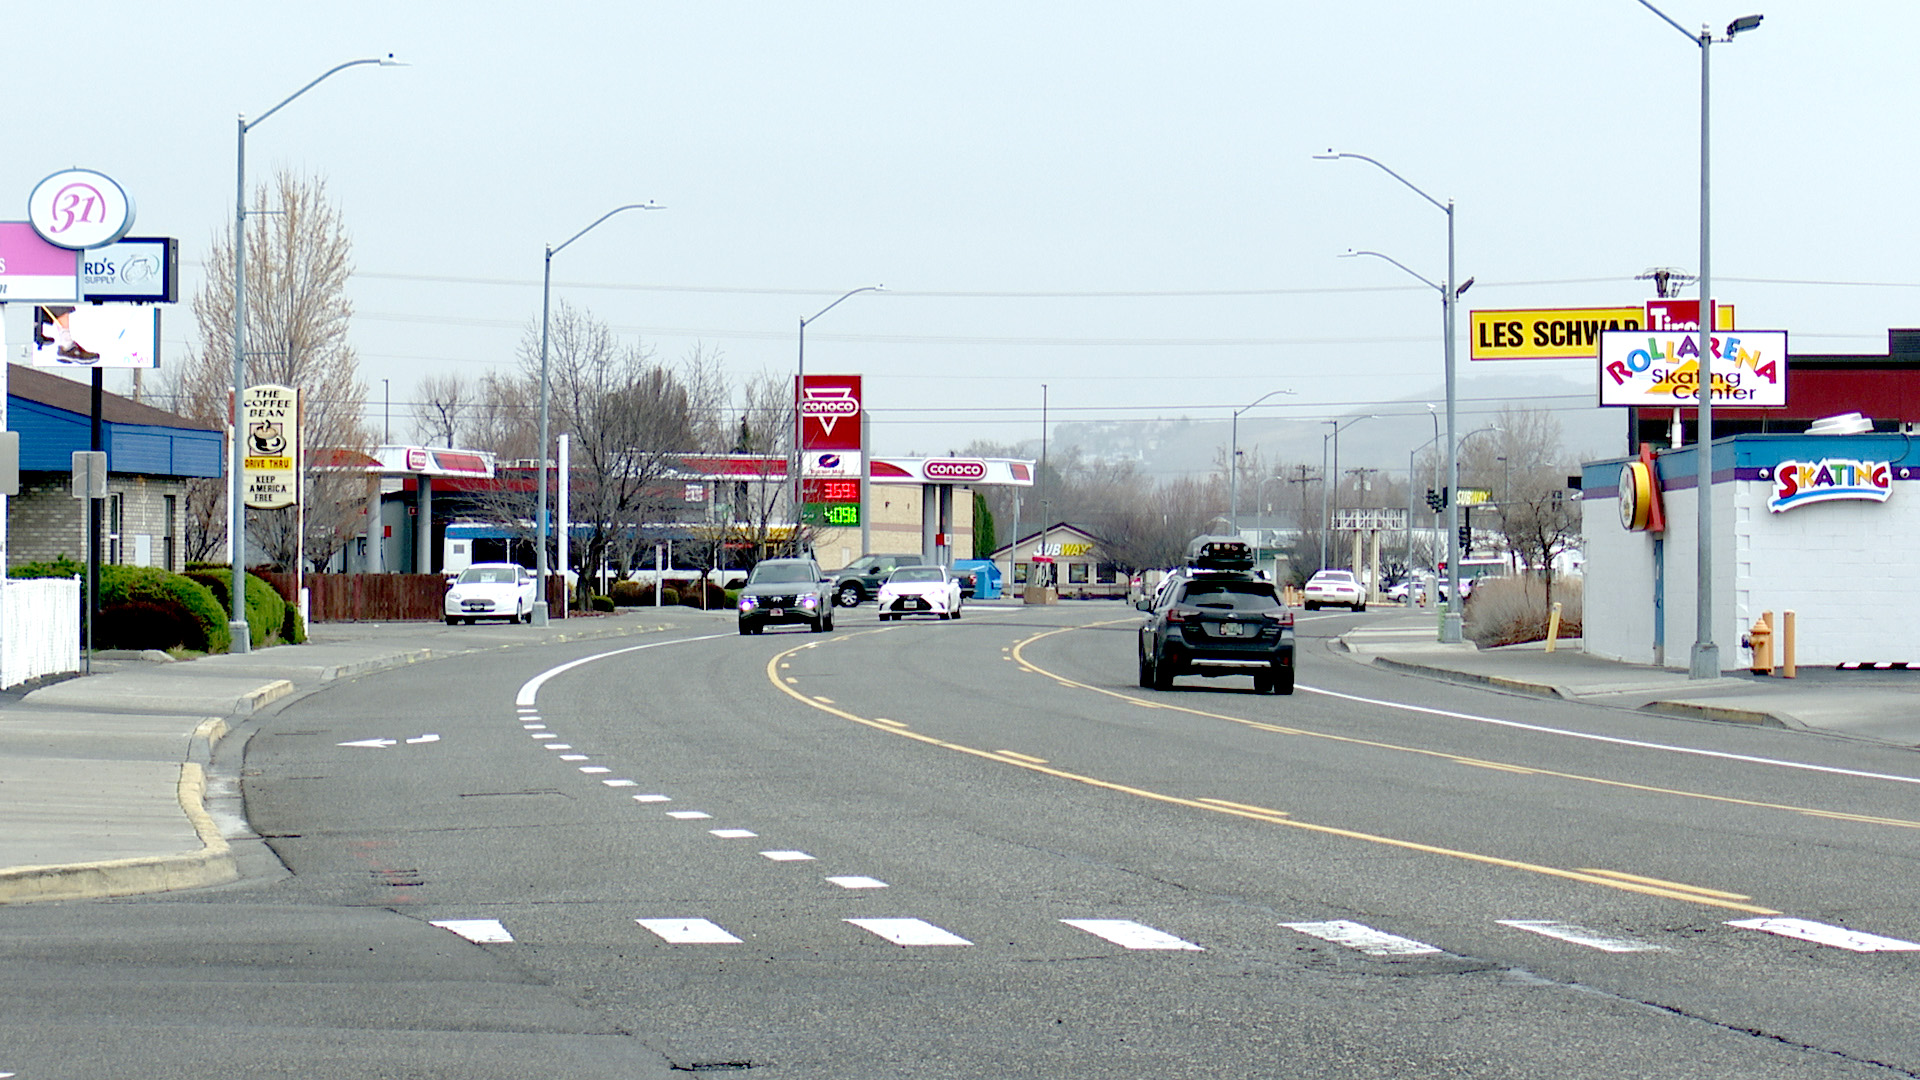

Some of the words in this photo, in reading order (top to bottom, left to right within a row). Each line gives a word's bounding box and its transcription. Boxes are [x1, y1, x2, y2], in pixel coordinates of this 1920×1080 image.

[51, 193, 96, 233] 31
[84, 257, 116, 275] RD'S
[84, 276, 116, 285] SUPPLY
[1479, 321, 1524, 348] LES
[1605, 334, 1777, 386] ROLLARENA
[1652, 368, 1741, 388] Skatng
[255, 390, 280, 398] THE
[243, 399, 292, 408] COFFEE
[250, 409, 285, 417] BEAN
[245, 459, 265, 468] DRIVE
[269, 459, 289, 468] THRU
[256, 475, 276, 483] KEEP
[1779, 464, 1889, 499] SKATING
[250, 484, 287, 493] AMERICA
[255, 494, 273, 502] FREE
[1456, 490, 1491, 505] SUBWAY
[1033, 543, 1094, 556] SUBWAY
